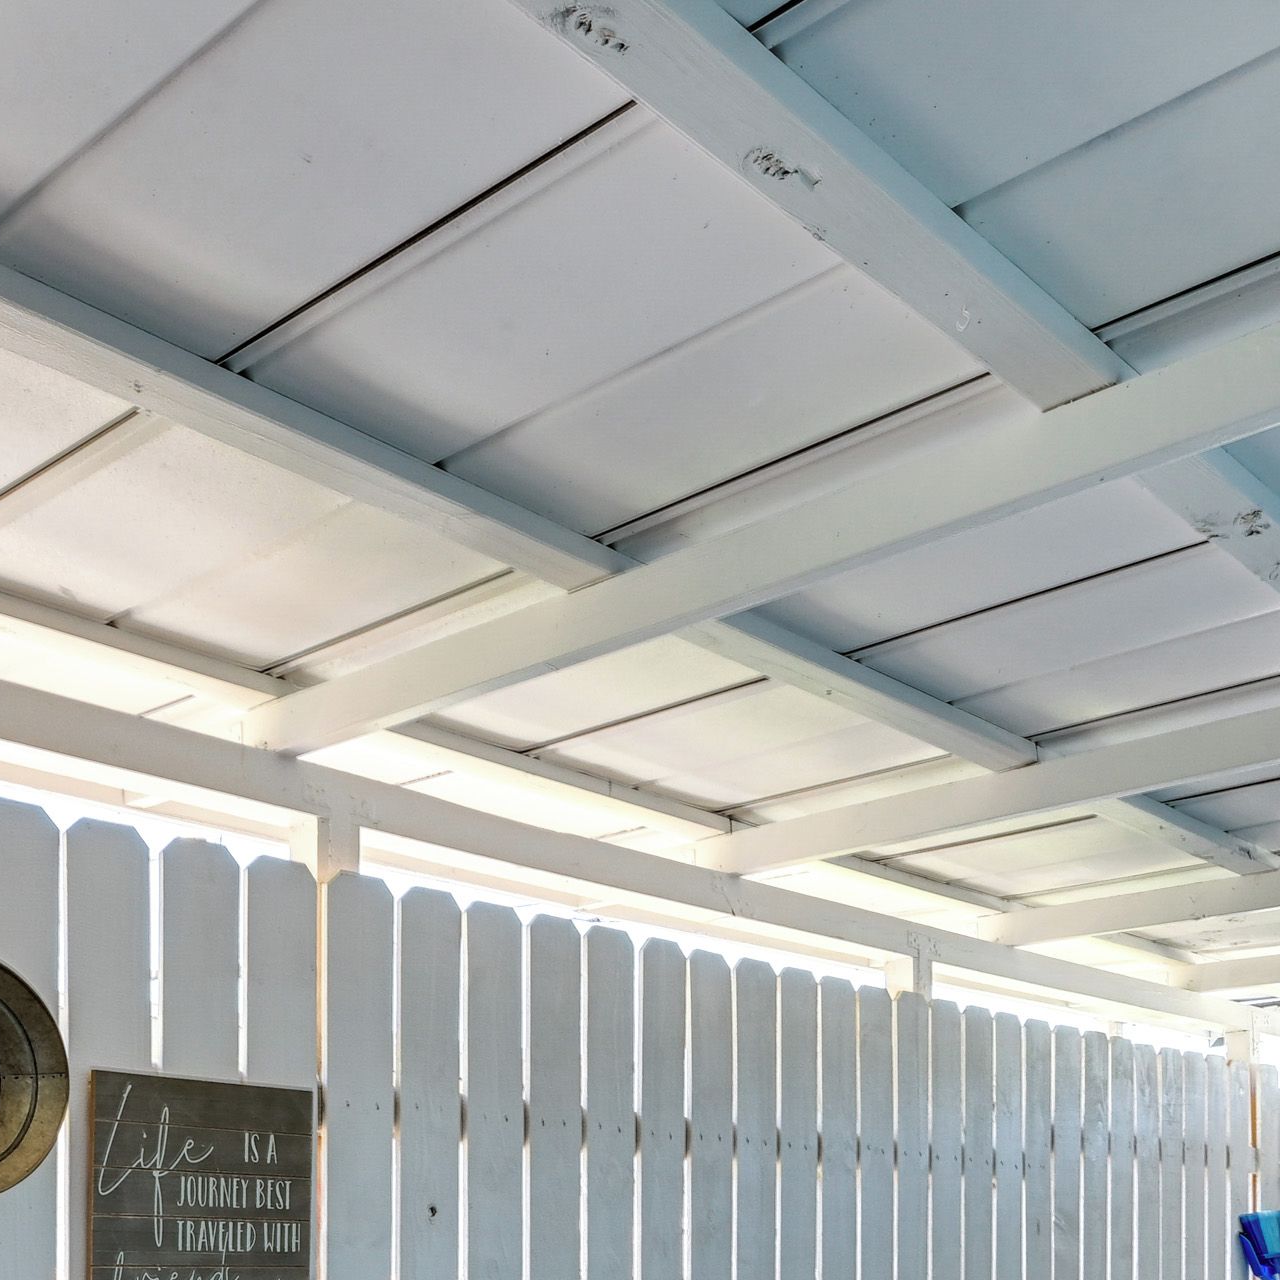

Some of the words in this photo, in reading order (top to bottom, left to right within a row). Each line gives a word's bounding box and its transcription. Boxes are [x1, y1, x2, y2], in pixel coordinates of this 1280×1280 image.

[98, 1085, 214, 1247] Life
[244, 1131, 261, 1164] IS
[266, 1133, 278, 1164] A
[176, 1175, 249, 1209] JOURNEY
[255, 1179, 293, 1210] BEST
[176, 1219, 257, 1253] TRAVELED
[263, 1222, 301, 1253] WITH
